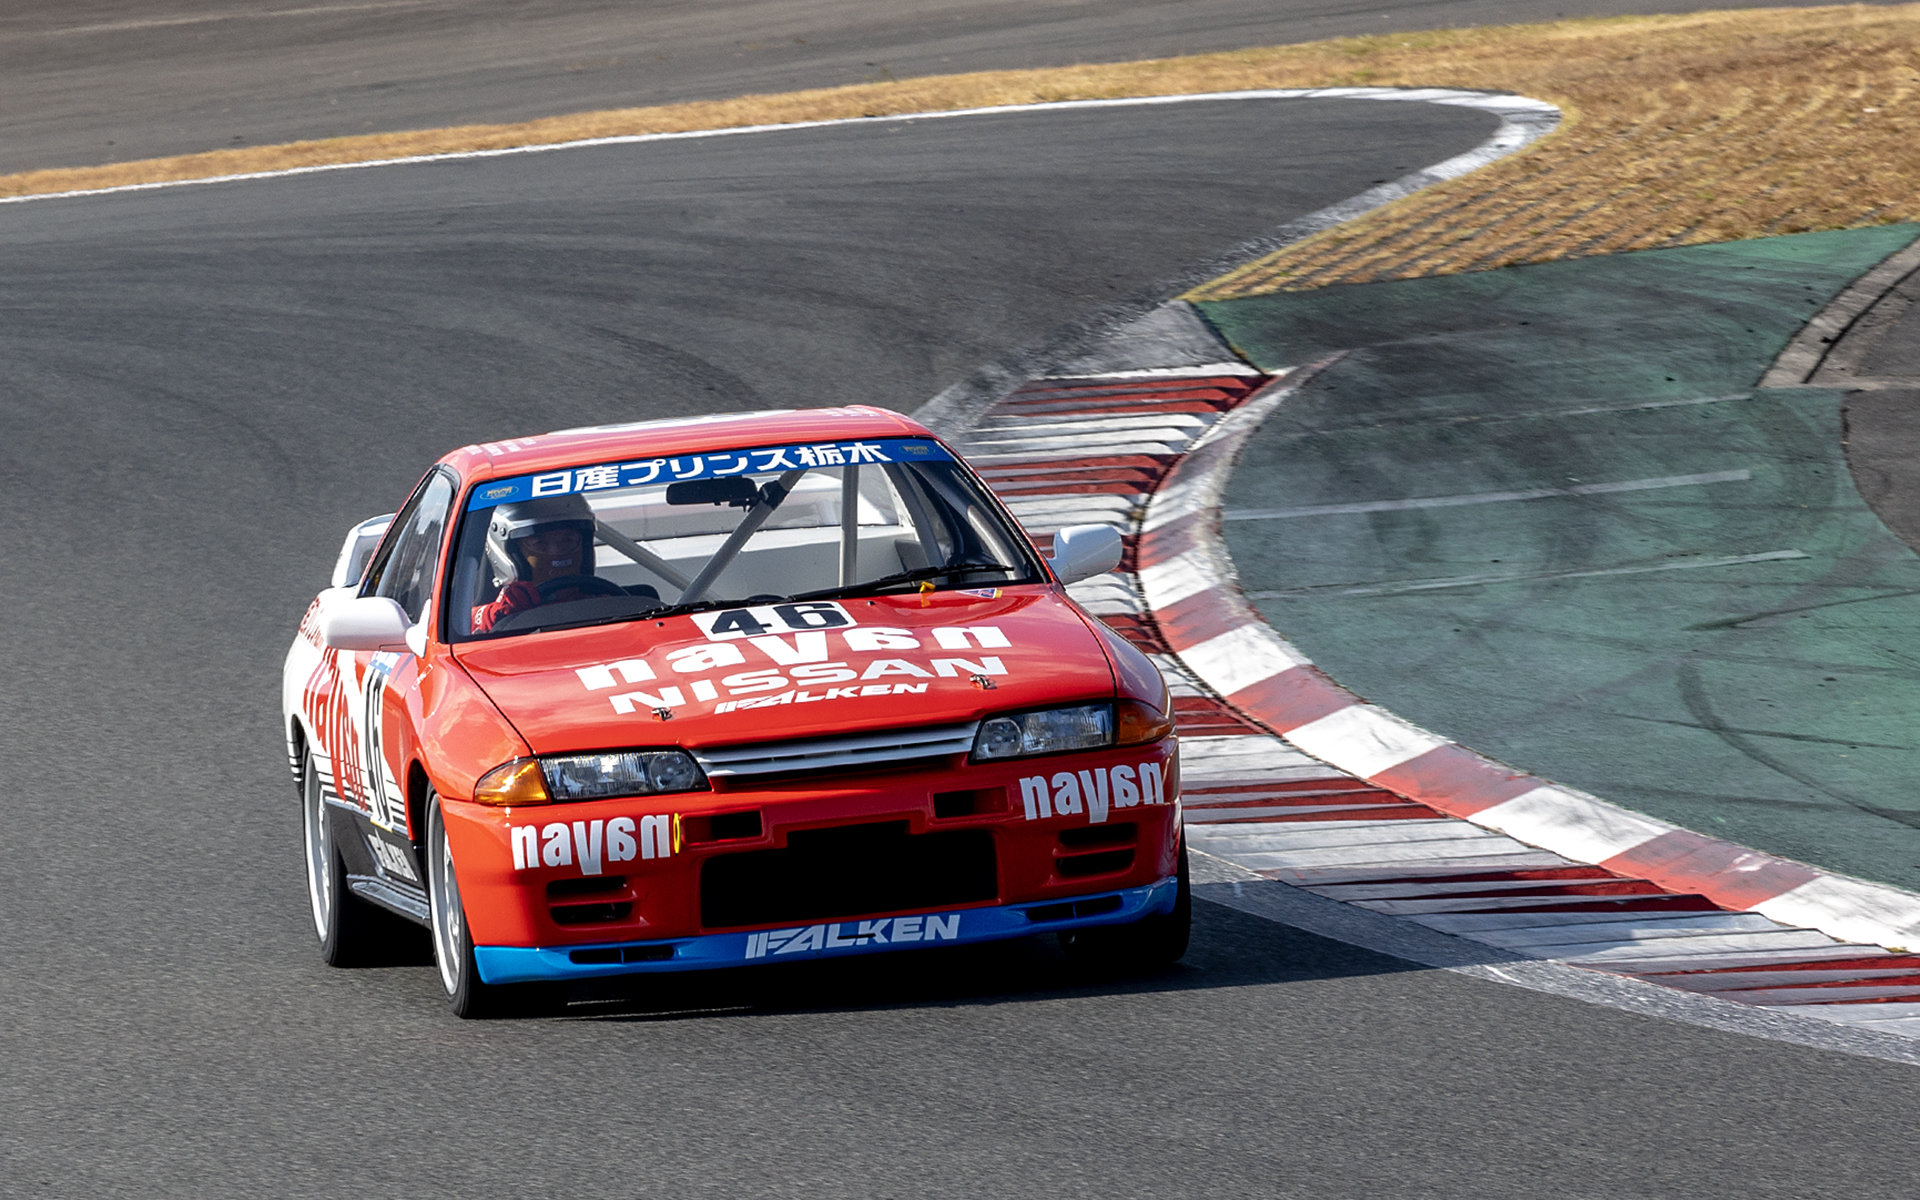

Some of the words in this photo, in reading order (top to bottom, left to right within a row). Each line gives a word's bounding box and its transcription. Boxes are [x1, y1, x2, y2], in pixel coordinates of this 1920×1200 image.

[531, 442, 891, 497] 日産プリンス栃木
[711, 603, 848, 634] 46
[608, 656, 1008, 715] NISSAN
